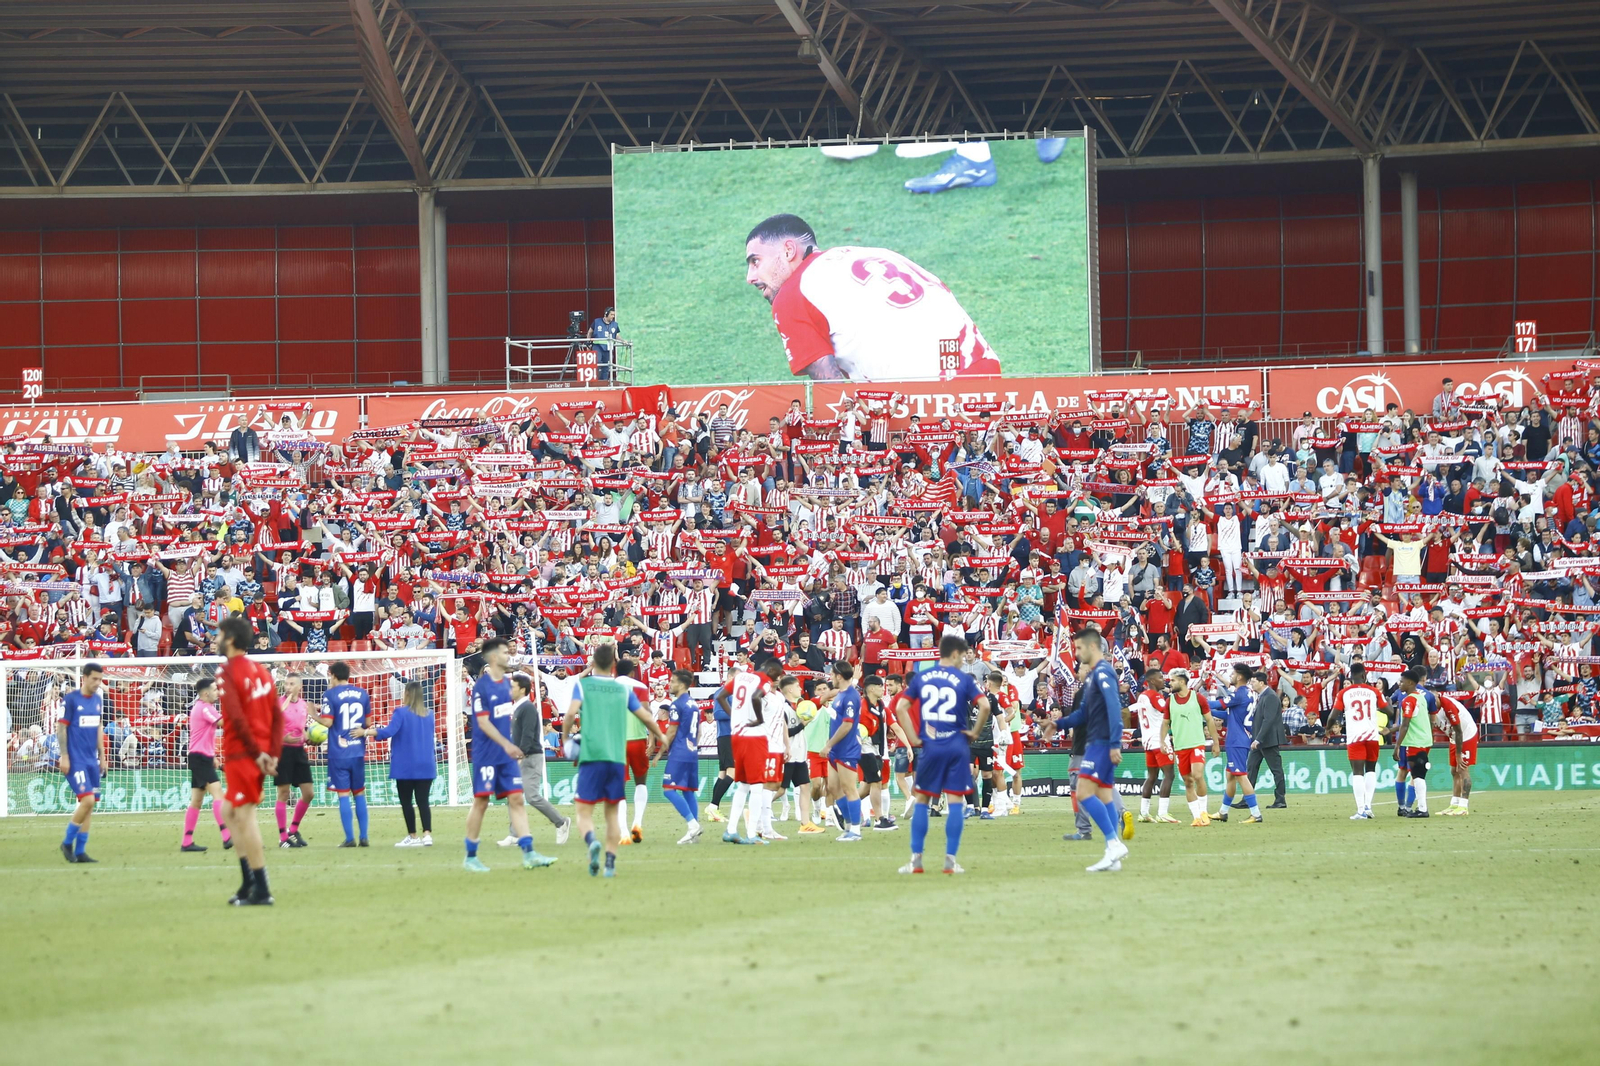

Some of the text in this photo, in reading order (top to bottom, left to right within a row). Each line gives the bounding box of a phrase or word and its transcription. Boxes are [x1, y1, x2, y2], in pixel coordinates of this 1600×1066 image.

[1515, 322, 1531, 335] 117
[940, 340, 957, 353] 118
[1516, 337, 1531, 352] 17
[577, 353, 594, 365] 119
[940, 356, 957, 369] 18
[23, 369, 39, 381] 120
[578, 367, 594, 381] 19
[23, 384, 40, 398] 20
[1057, 396, 1079, 408] DE
[1316, 385, 1385, 414] CASI
[921, 670, 949, 682] OSCAR
[735, 685, 747, 709] 9
[1349, 691, 1372, 699] APPIAH
[921, 684, 957, 722] 22
[1350, 699, 1372, 721] 31
[339, 702, 364, 730] 12
[74, 770, 86, 784] 11
[480, 766, 494, 781] 19
